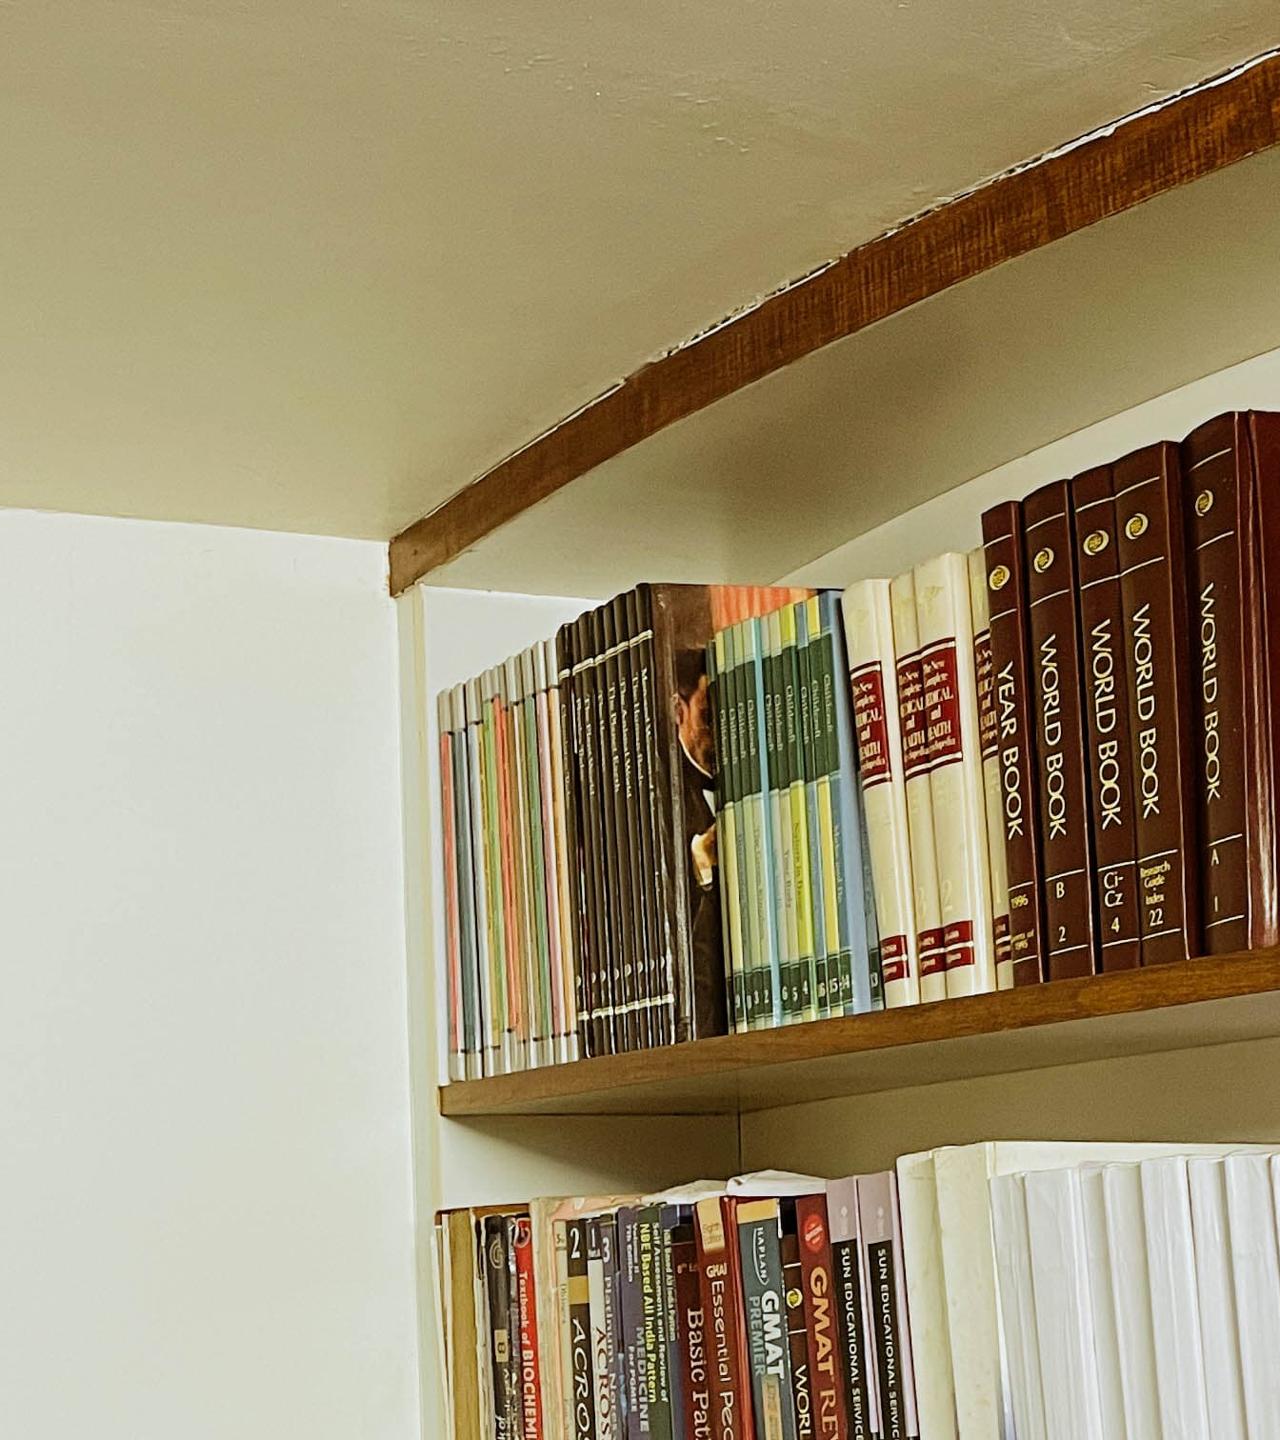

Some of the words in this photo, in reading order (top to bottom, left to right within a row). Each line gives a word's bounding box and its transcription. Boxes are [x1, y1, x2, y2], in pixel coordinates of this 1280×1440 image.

[1091, 619, 1117, 734] WORLD
[1132, 604, 1156, 722] WORLD
[1200, 583, 1218, 704] WORLD
[997, 661, 1019, 739] YEAR
[1040, 634, 1061, 747] WORLD
[1003, 746, 1024, 840] BOOK
[1046, 752, 1067, 840] BOOK
[1098, 740, 1122, 830] BOOK
[1139, 727, 1160, 820] BOOK
[1203, 710, 1221, 805] BOOK
[1211, 849, 1219, 866] A
[1058, 927, 1067, 944] 2
[1111, 917, 1120, 933] 4
[1149, 909, 1163, 927] 22
[756, 1227, 768, 1286] KAPLAN
[687, 1307, 705, 1384] Basic
[710, 1280, 731, 1383] Essential
[761, 1290, 784, 1379] GMAT
[810, 1266, 835, 1380] GMAT
[646, 1350, 657, 1403] Pattern
